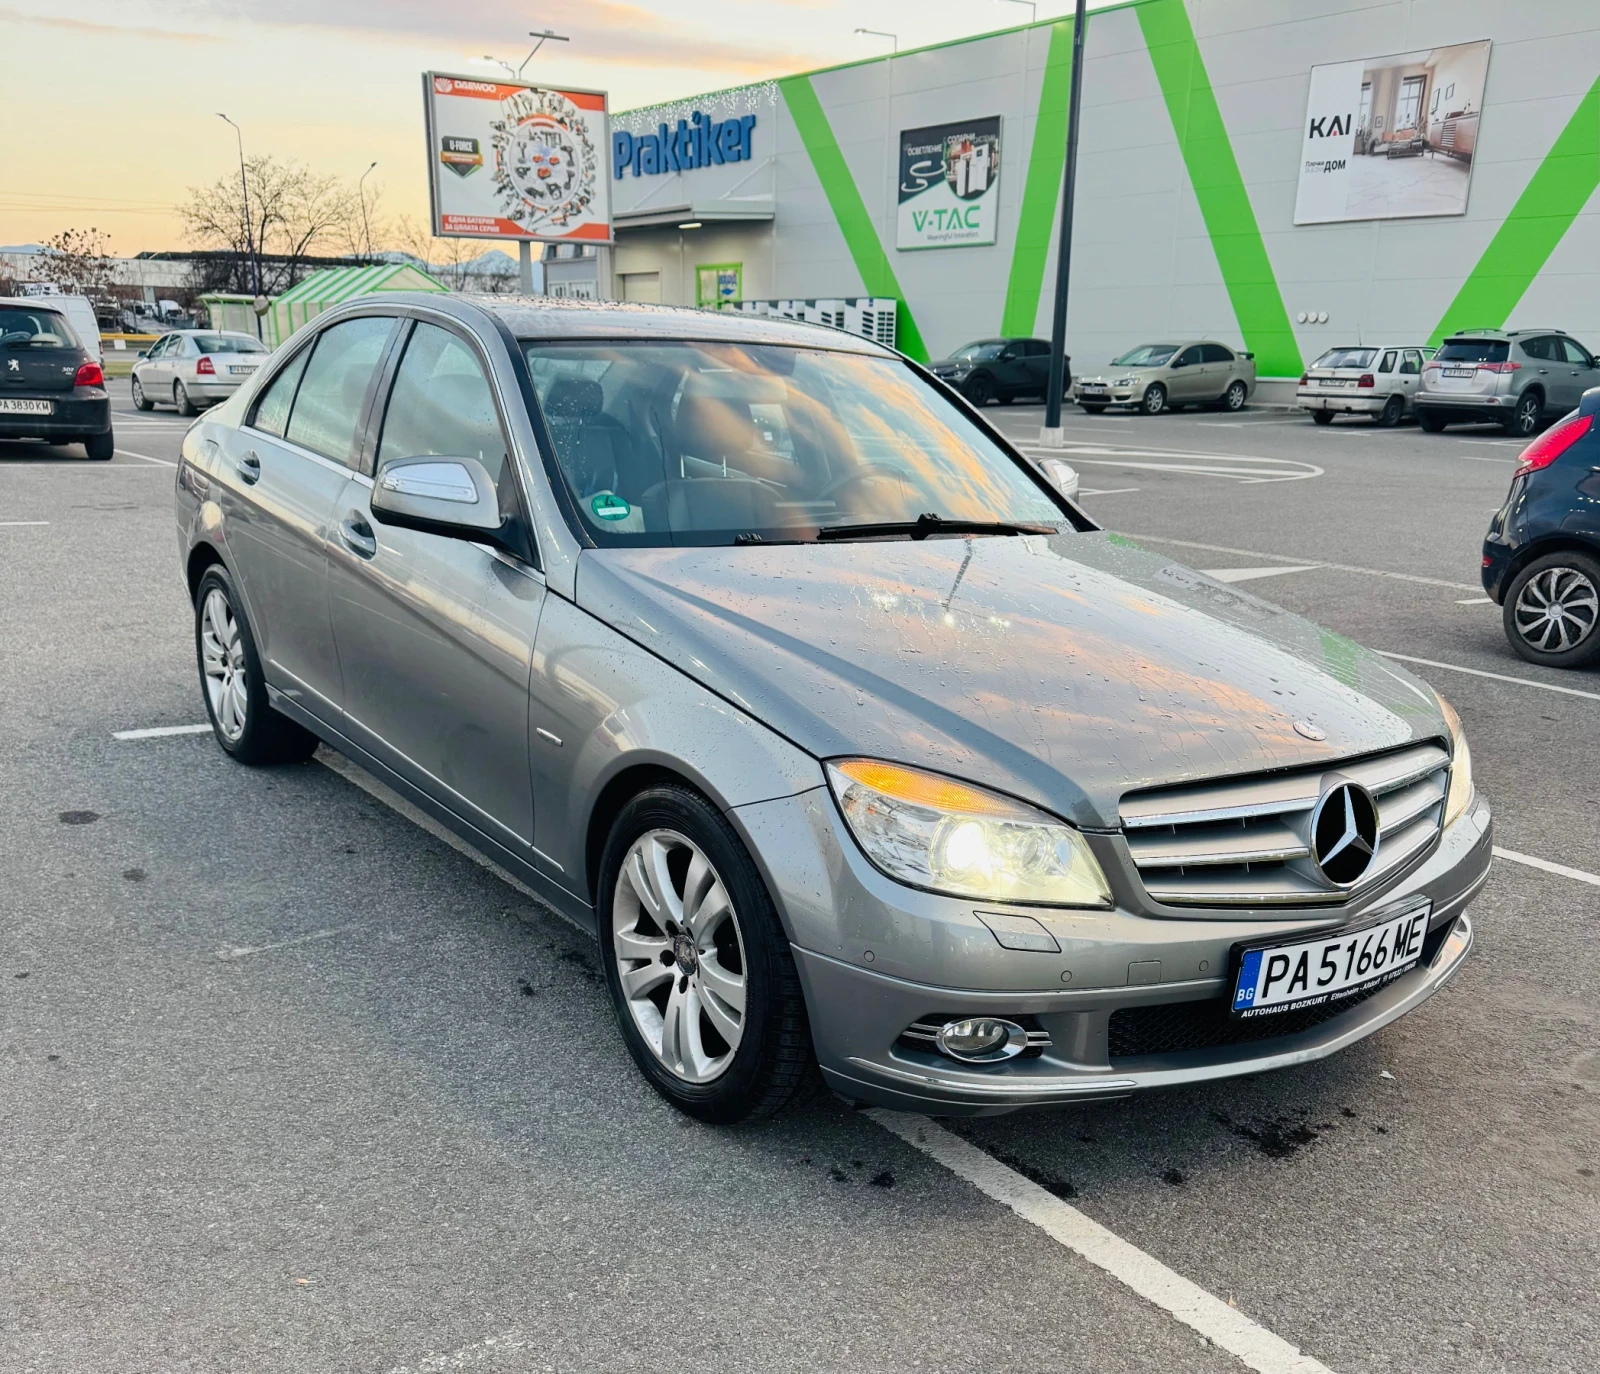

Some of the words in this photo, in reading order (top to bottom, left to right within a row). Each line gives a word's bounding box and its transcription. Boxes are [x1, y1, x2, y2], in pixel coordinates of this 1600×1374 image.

[454, 80, 496, 93] DAEWOO
[1309, 113, 1351, 139] KAI
[449, 140, 474, 152] U-FORCE
[613, 110, 756, 180] Praktiker
[1323, 160, 1346, 173] ДОМ
[912, 205, 980, 232] V-TAC
[605, 495, 615, 508] 4
[1261, 950, 1309, 999] PA
[1317, 928, 1389, 987] 5166
[1391, 913, 1425, 964] ME
[1236, 987, 1254, 1002] BG
[1241, 1004, 1289, 1018] AUTOHAUS
[1290, 995, 1328, 1010] BOZKURT
